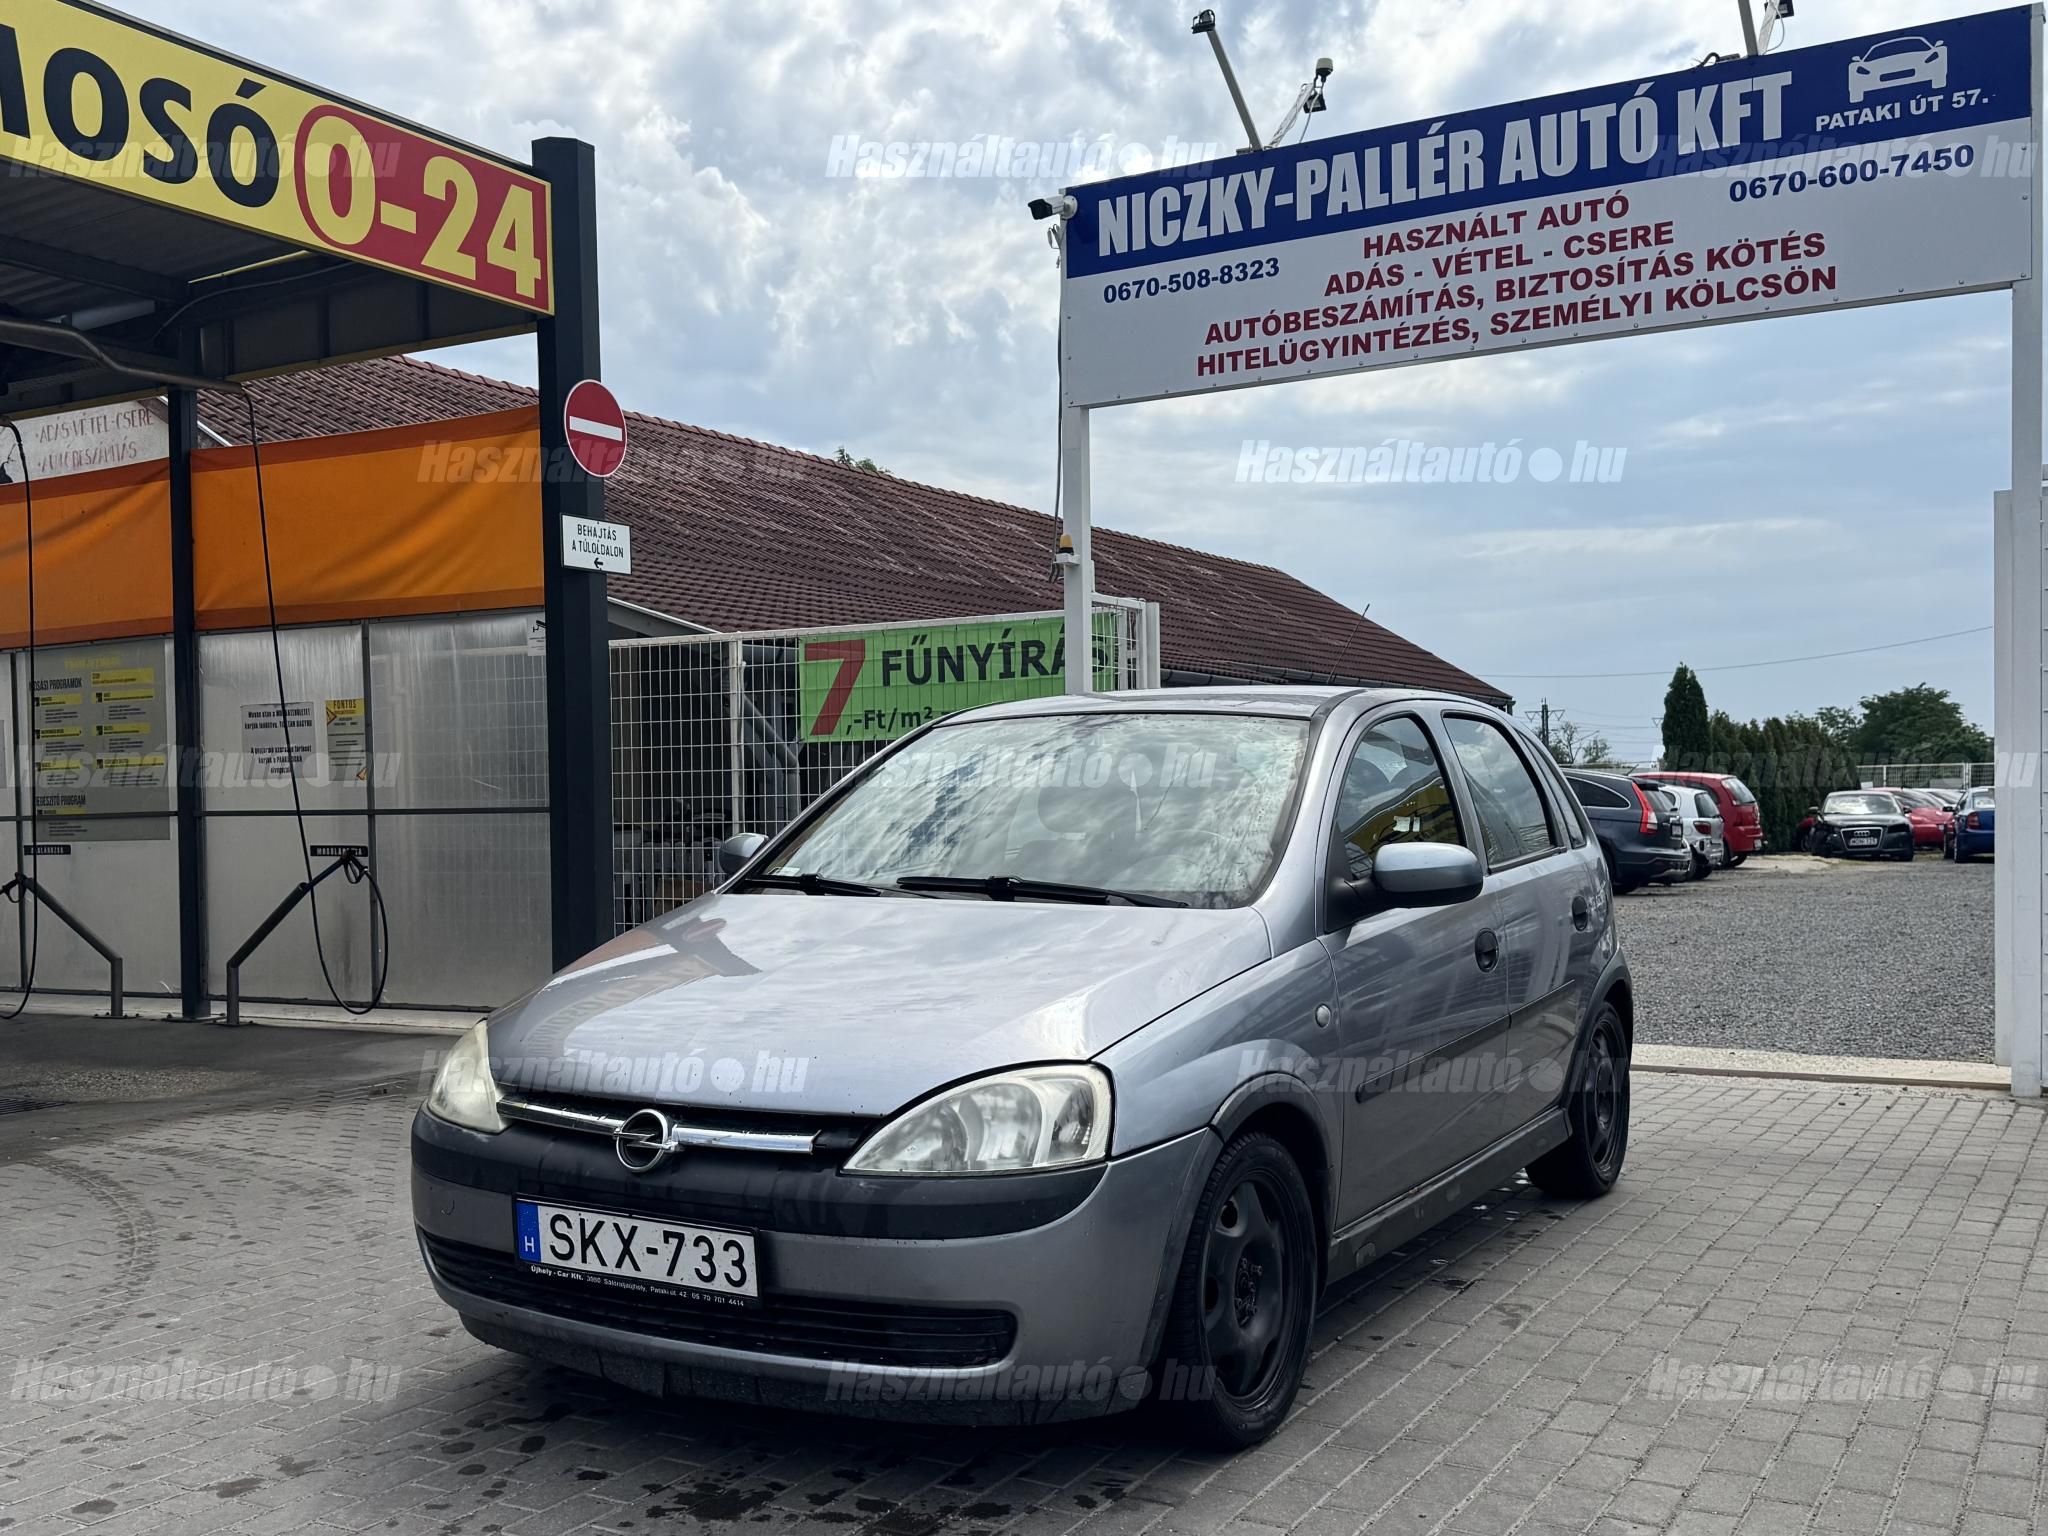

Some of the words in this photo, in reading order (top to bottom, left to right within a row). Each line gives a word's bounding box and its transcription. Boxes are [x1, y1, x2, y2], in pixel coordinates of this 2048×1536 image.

[1816, 102, 1900, 131] PATAKI
[1910, 94, 1943, 115] ÚT
[1951, 89, 1988, 109] 57.
[1099, 121, 1484, 256] NICZKY-PALLÉR
[1499, 82, 1658, 184] AUTÓ
[1677, 71, 1792, 155] KFT
[1729, 145, 1974, 203] 0670-600-7450
[305, 115, 541, 299] 0-24
[1364, 210, 1527, 259] HASZNÁLT
[1537, 190, 1629, 230] AUTÓ
[1104, 257, 1280, 303] 0670-508-8323
[1204, 283, 1484, 345] AUTÓBESZÁMÍTÁS,
[1496, 250, 1694, 302] BIZTOSÍTÁS
[1707, 230, 1825, 272] KÖTÉS
[1324, 262, 1405, 297] ADÁS
[1432, 244, 1533, 278] VÉTEL
[1564, 221, 1674, 259] CSERE
[1198, 316, 1479, 377] HITELÜGYINTÉZÉS,
[1490, 291, 1652, 335] SZEMÉLYI
[1665, 265, 1836, 312] KÖLCSÖN
[572, 539, 577, 551] A
[578, 539, 624, 558] TÚLOLDALON
[577, 523, 617, 541] BEHAJTÁS
[333, 699, 356, 708] FONTOS
[804, 639, 865, 736] 7
[524, 1235, 535, 1253] H
[550, 1214, 747, 1288] SKX-733
